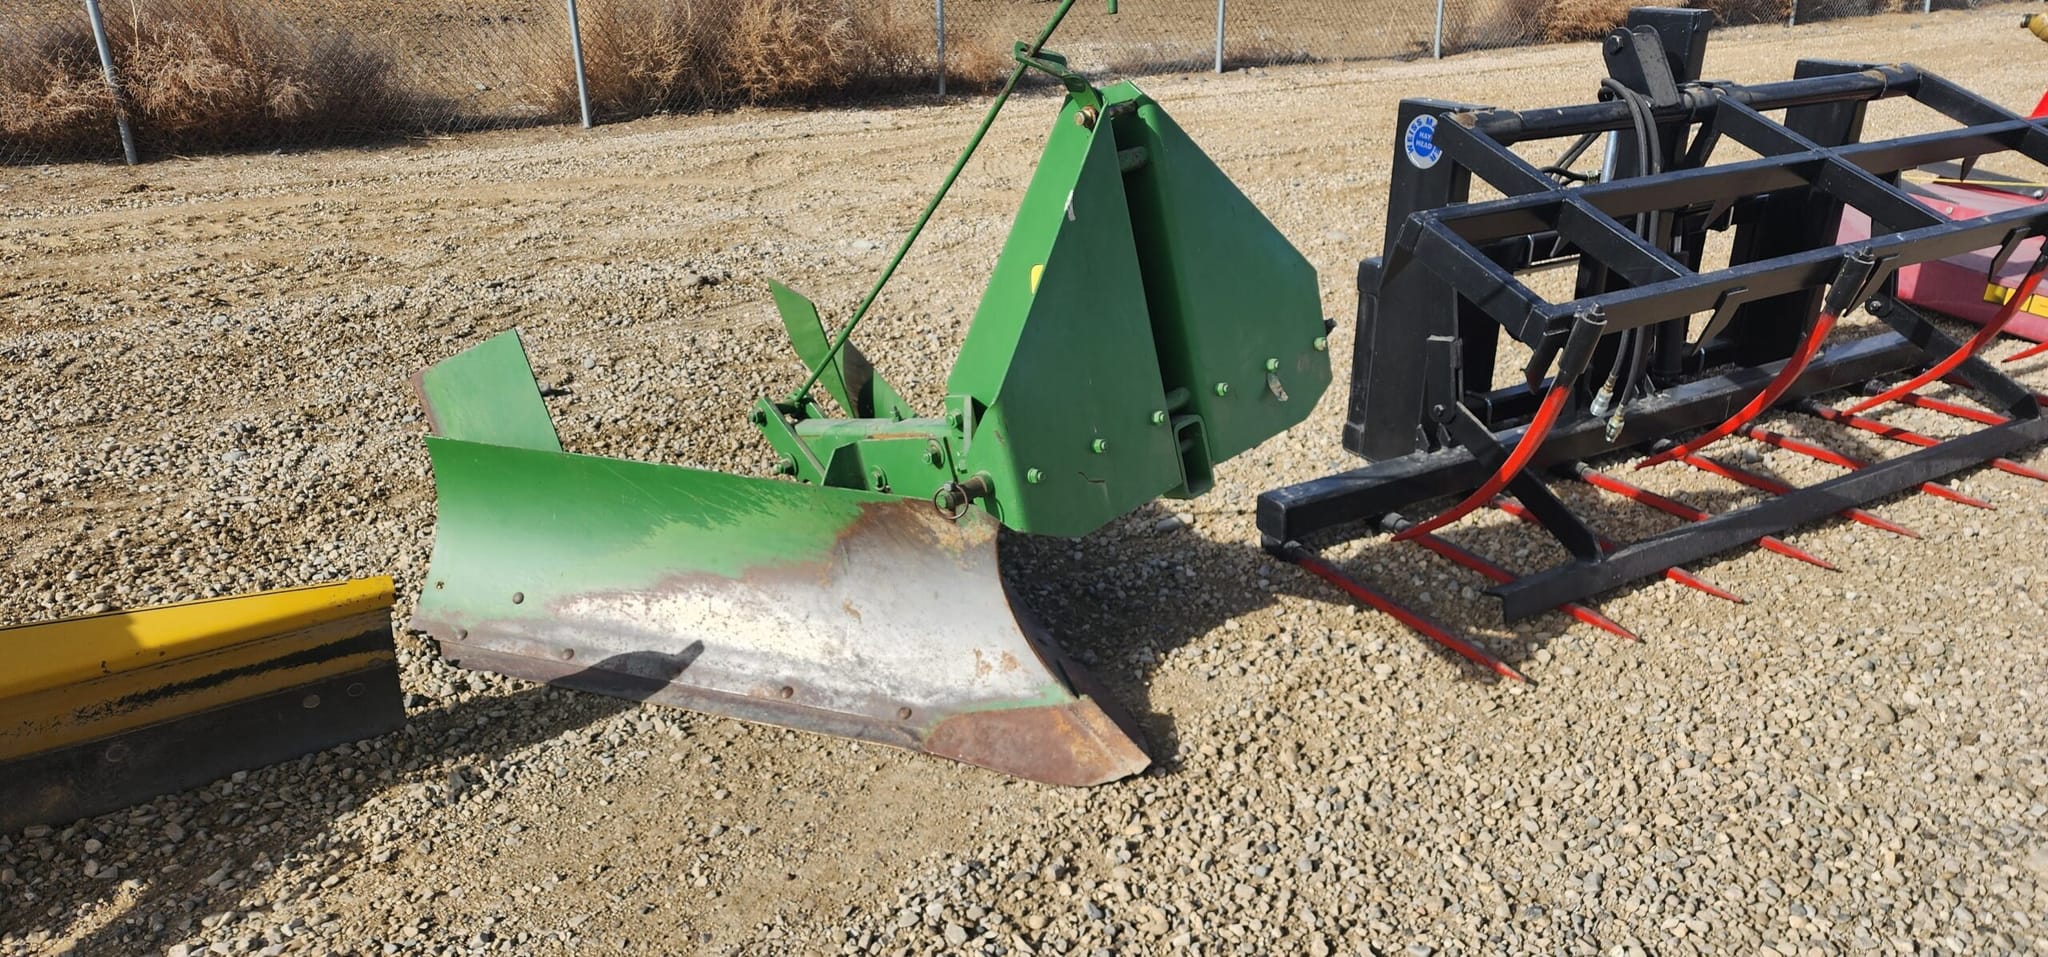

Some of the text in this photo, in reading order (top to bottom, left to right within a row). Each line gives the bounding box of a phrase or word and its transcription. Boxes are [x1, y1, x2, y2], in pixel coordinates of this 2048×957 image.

[1407, 118, 1422, 154] WEISS
[1419, 131, 1432, 139] HAY
[1416, 140, 1433, 150] HEAD
